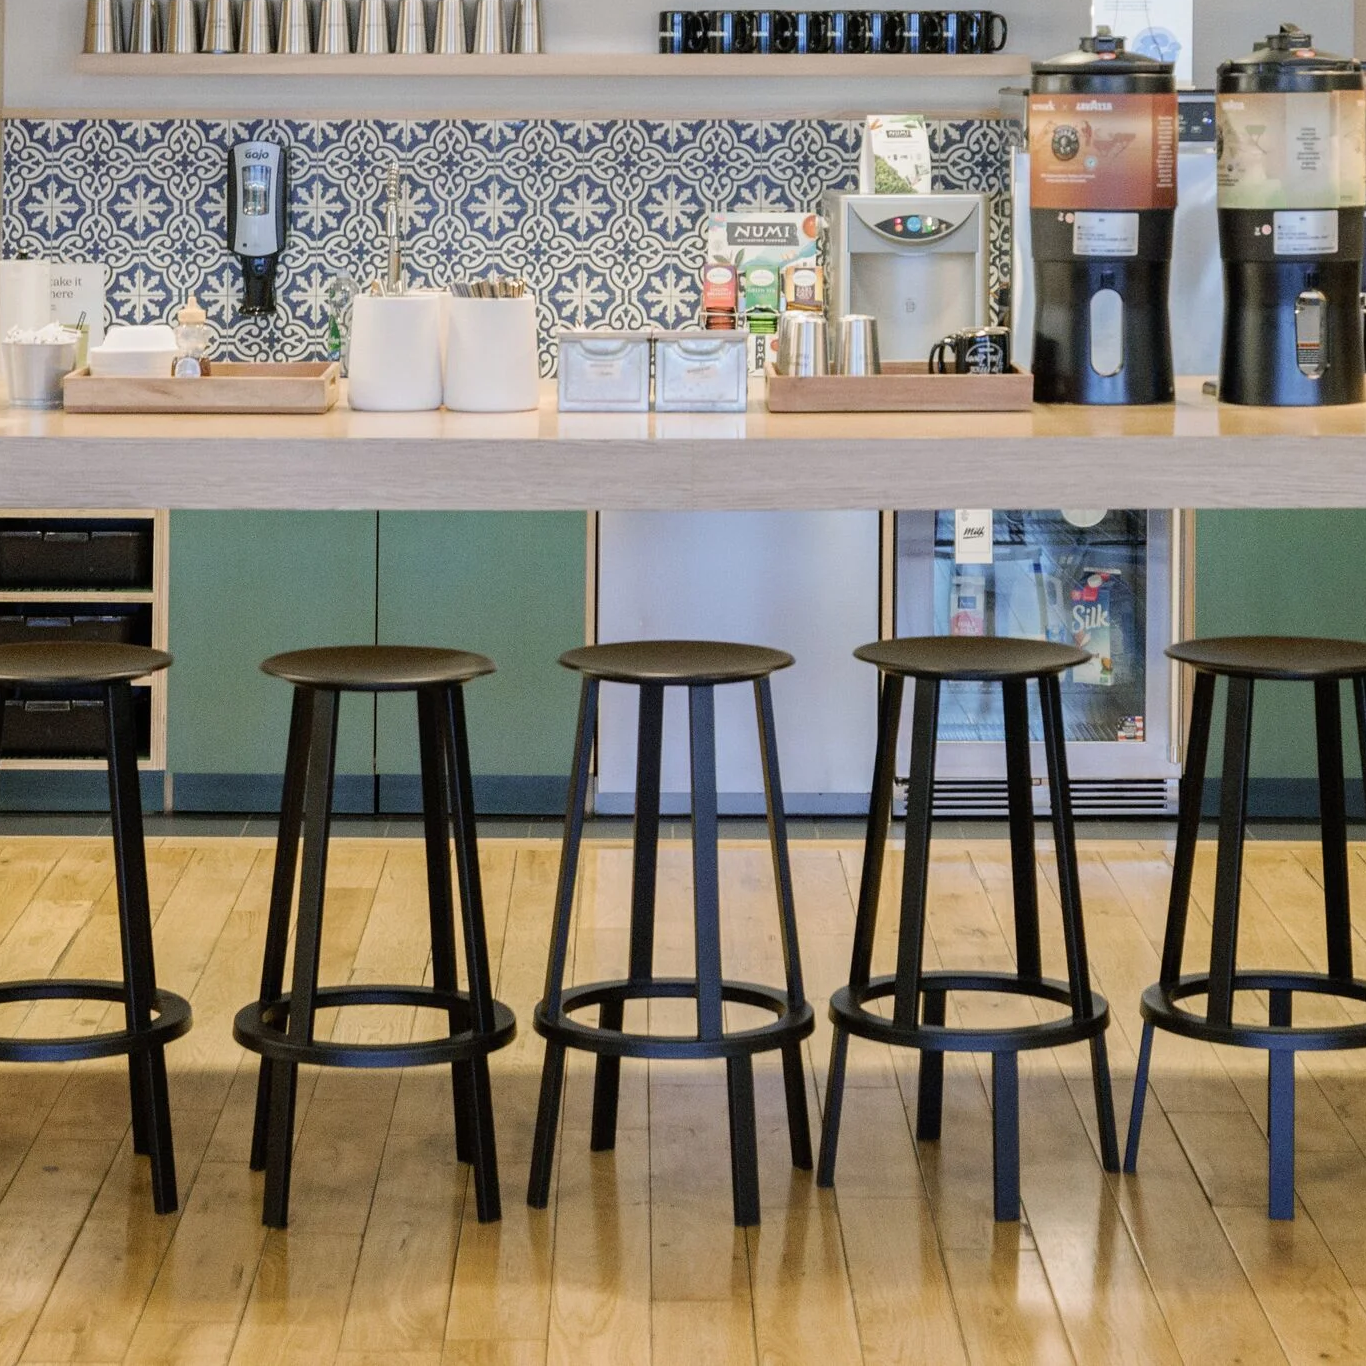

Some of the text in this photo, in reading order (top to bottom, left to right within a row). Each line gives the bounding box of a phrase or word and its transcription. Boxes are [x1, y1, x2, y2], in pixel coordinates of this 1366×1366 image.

[245, 149, 269, 161] GOJO
[734, 225, 790, 238] NUMI
[50, 276, 81, 286] ake it
[756, 338, 765, 365] NUMI
[963, 526, 985, 537] Milk
[1071, 604, 1110, 633] Silk
